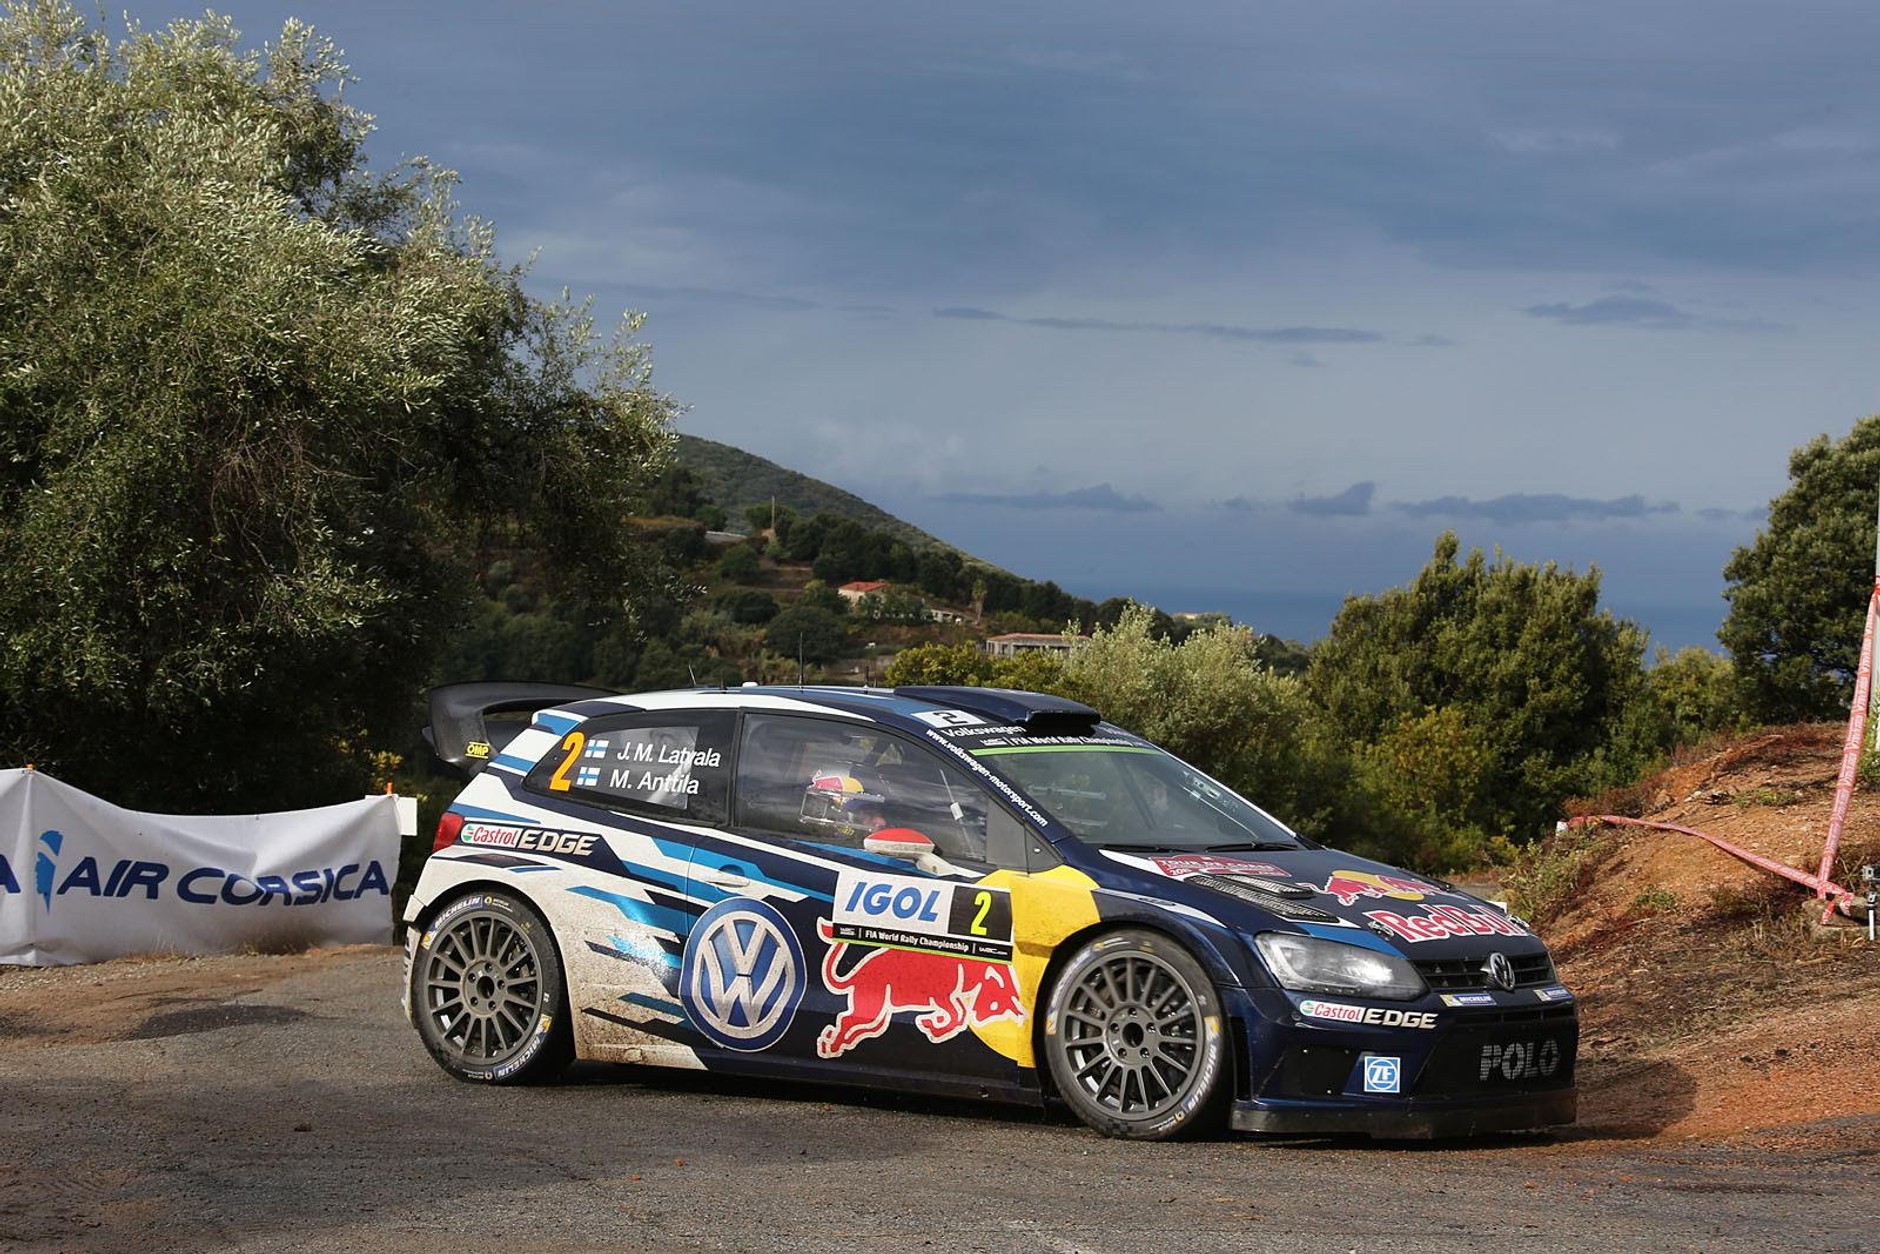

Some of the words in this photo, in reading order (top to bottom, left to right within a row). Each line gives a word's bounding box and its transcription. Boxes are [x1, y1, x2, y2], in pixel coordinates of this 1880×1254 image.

[933, 711, 967, 725] 2
[940, 725, 1027, 738] Volkswagen
[467, 744, 489, 757] OMP
[549, 731, 586, 792] 2
[617, 741, 631, 761] J.
[633, 742, 654, 763] M.
[658, 744, 722, 768] Latvala
[609, 768, 632, 790] M.
[637, 769, 700, 795] Anttila
[925, 728, 1049, 828] www.volkswagen-motorsport.com
[473, 826, 519, 846] Castrol
[516, 829, 601, 856] EDGE
[57, 856, 170, 900] AIR
[177, 860, 390, 906] CORSICA
[434, 896, 482, 929] MICHELIN
[845, 881, 941, 922] IGOL
[970, 891, 992, 936] 2
[865, 930, 878, 940] FIA
[878, 930, 899, 942] World
[899, 933, 919, 946] Rally
[919, 937, 970, 953] Championship
[1314, 1003, 1361, 1022] Castrol
[1363, 1008, 1439, 1030] EDGE
[495, 1036, 542, 1079] MICHELIN
[1480, 1039, 1559, 1081] POLO
